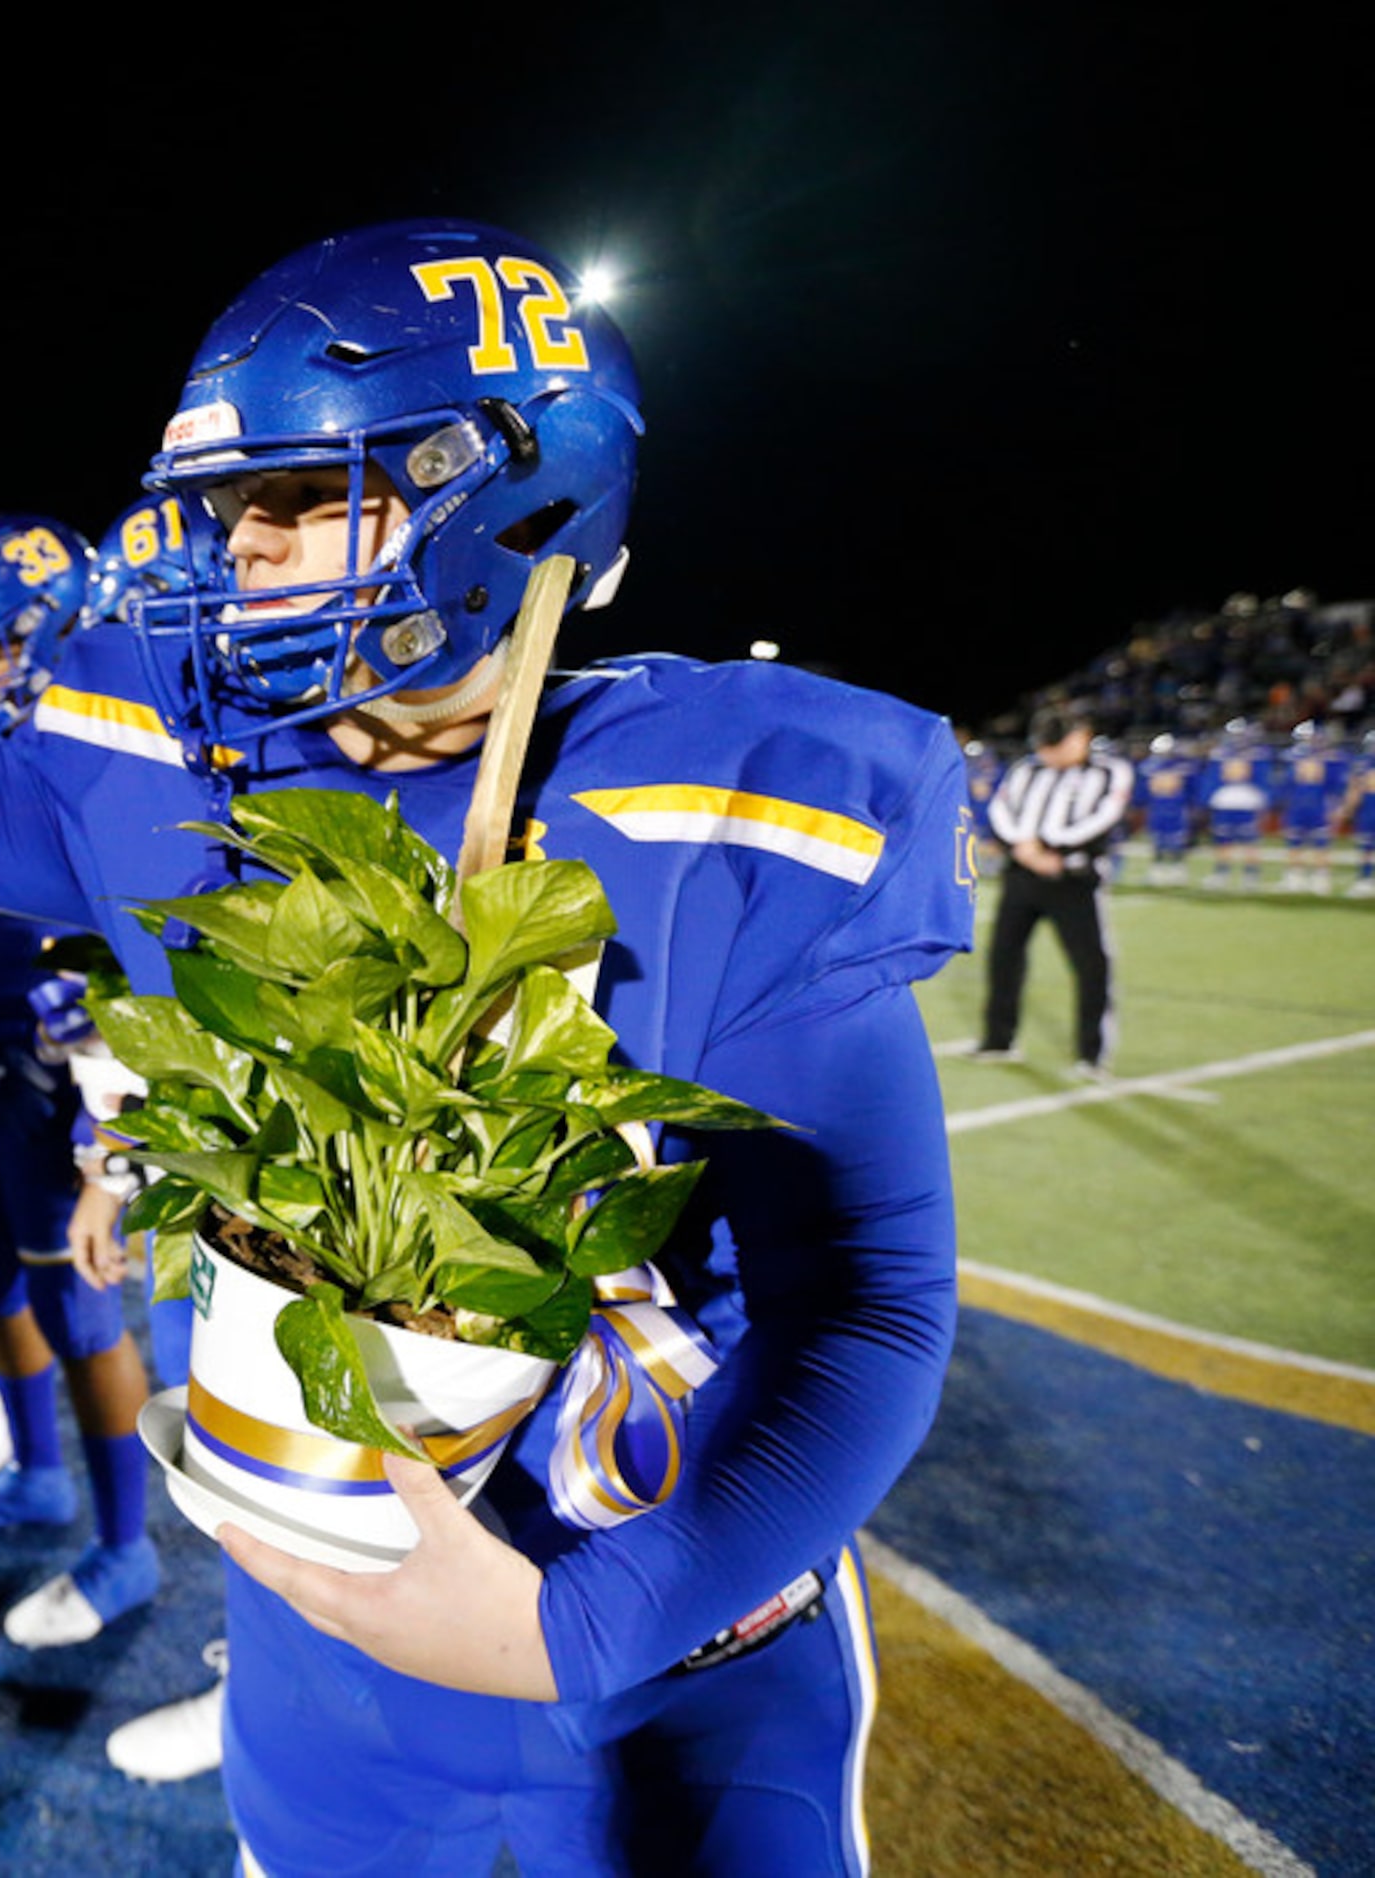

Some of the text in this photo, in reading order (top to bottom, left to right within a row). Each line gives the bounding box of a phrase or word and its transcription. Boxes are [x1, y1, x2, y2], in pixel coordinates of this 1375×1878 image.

[409, 256, 590, 375] 72
[1, 527, 72, 587] 33
[121, 497, 184, 568] 61
